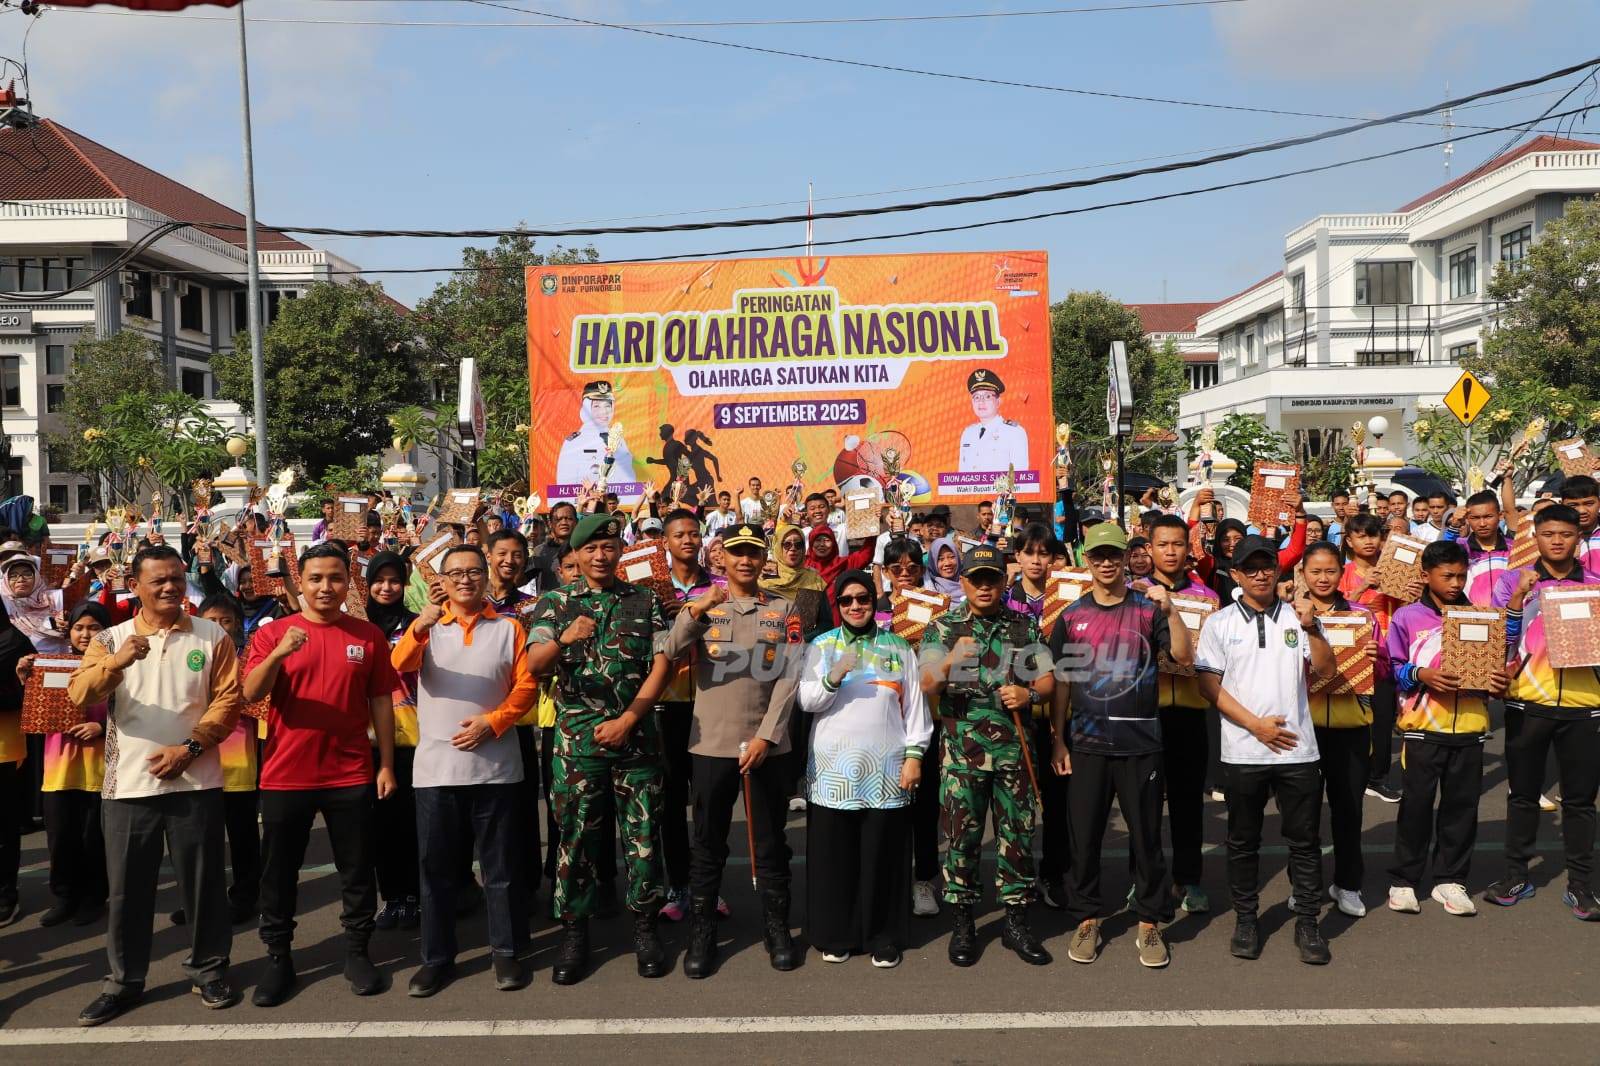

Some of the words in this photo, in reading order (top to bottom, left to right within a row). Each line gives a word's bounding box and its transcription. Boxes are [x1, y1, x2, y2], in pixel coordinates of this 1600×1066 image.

[561, 274, 621, 285] DINPORAPAR
[580, 284, 622, 293] PURWOREJO
[740, 294, 831, 314] PERINGATAN
[0, 316, 20, 325] EJO
[577, 319, 655, 365] HARI
[664, 313, 836, 363] OLAHRAGA
[843, 309, 1000, 355] NASIONAL
[688, 367, 773, 389] OLAHRAGA
[776, 365, 850, 387] SATUKAN
[854, 364, 889, 383] KITA
[720, 407, 731, 425] 9
[734, 403, 817, 425] SEPTEMBER
[820, 402, 860, 421] 2025
[943, 475, 960, 483] DION
[961, 474, 981, 482] AGASI
[559, 486, 570, 495] HJ.
[624, 484, 635, 493] SH
[973, 485, 992, 494] Bupati
[709, 617, 731, 625] NDRY
